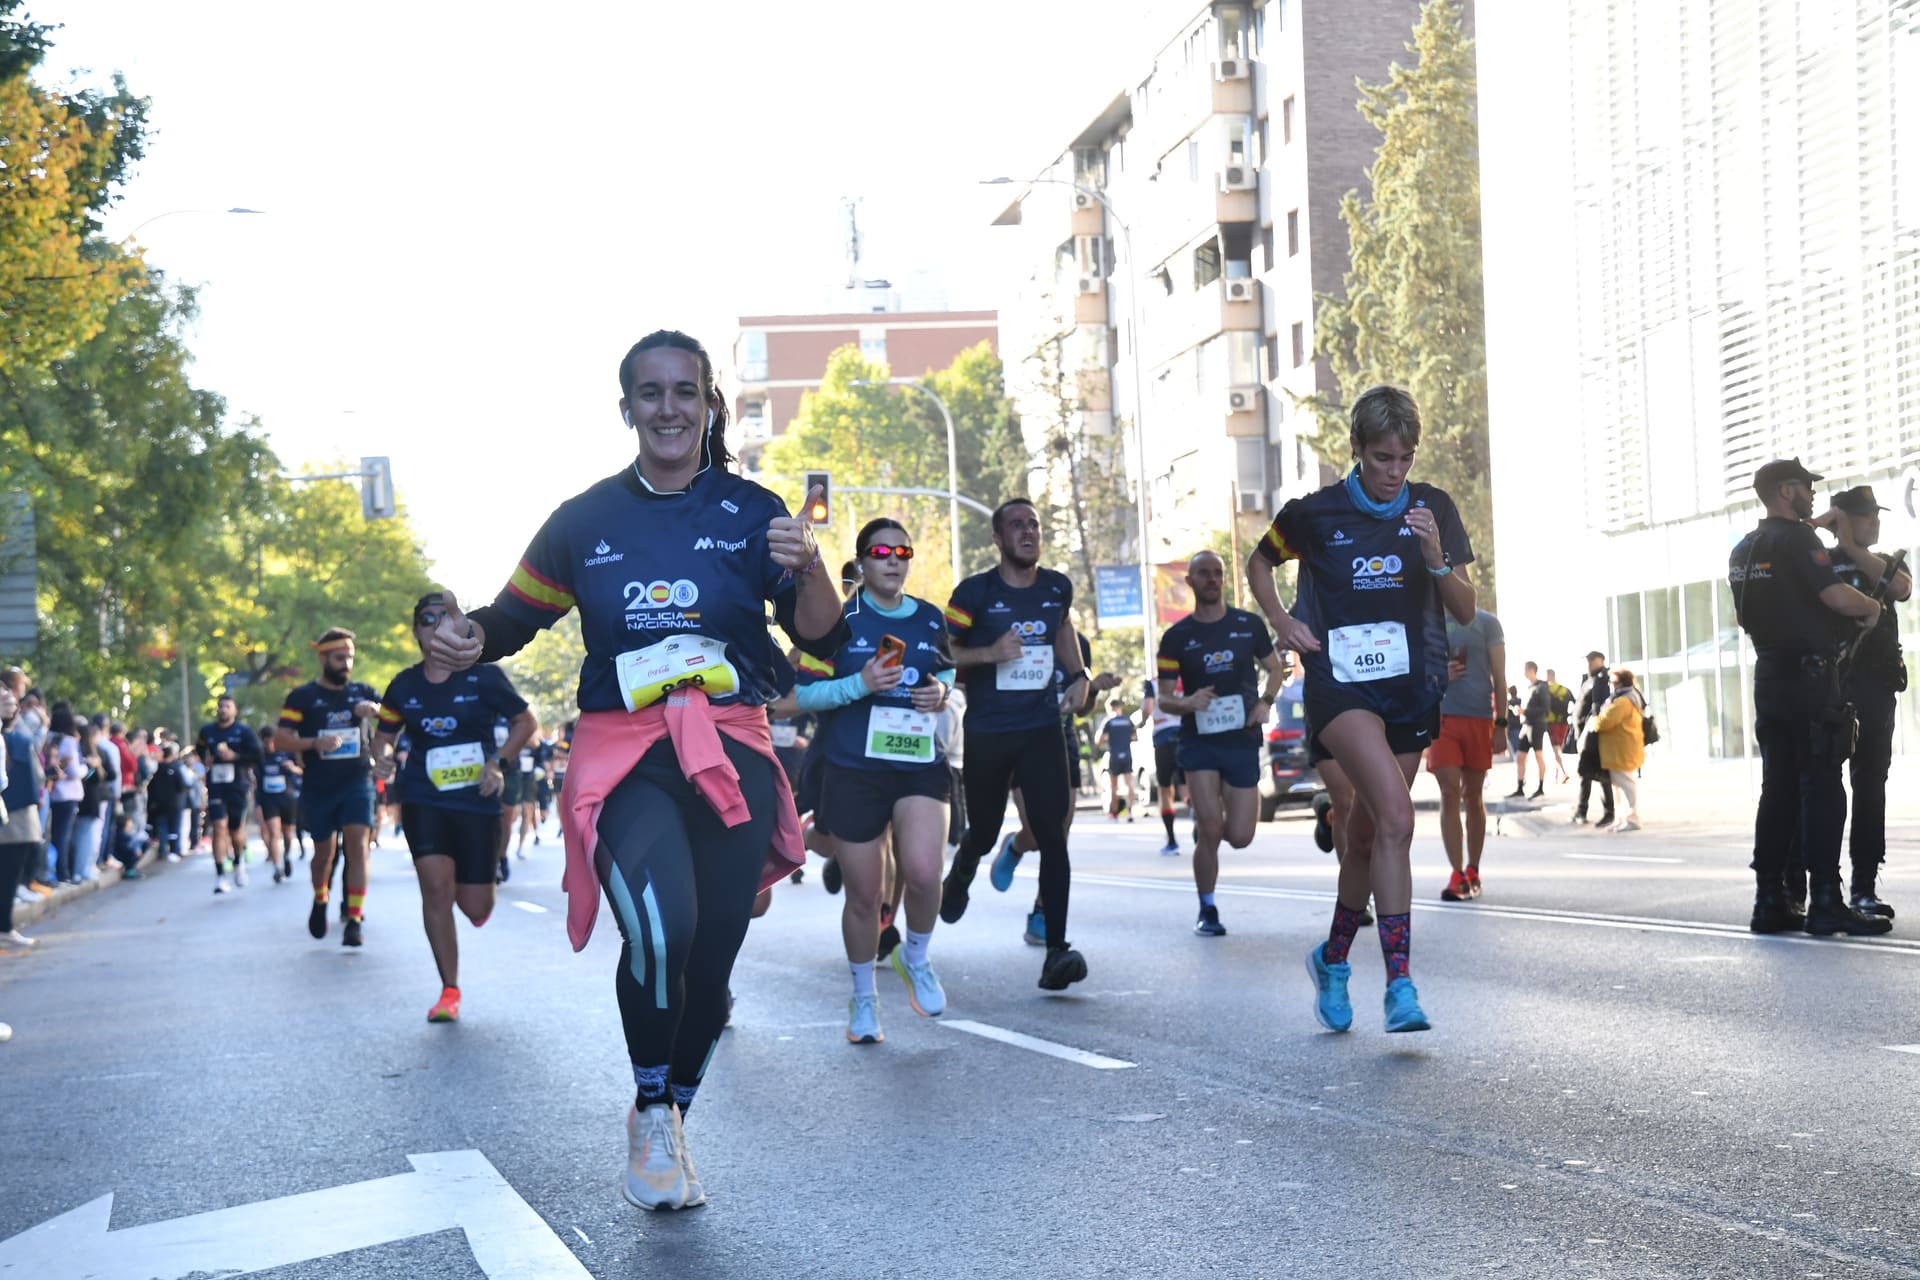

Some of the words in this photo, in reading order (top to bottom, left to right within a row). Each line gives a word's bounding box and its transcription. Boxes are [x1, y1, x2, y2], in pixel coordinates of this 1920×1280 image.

[717, 538, 747, 552] mupol
[584, 553, 624, 567] Santander
[1352, 555, 1402, 577] 200
[1353, 577, 1393, 585] POLICIA
[1353, 582, 1404, 591] NACIONAL
[623, 578, 699, 611] 200
[625, 611, 685, 623] POLICIA
[627, 619, 701, 631] NACIONAL
[1354, 652, 1385, 668] 460
[1010, 669, 1043, 681] 4490
[1356, 665, 1386, 675] SANDRA
[421, 716, 457, 732] 200
[884, 734, 920, 749] 2394
[441, 766, 474, 780] 2439
